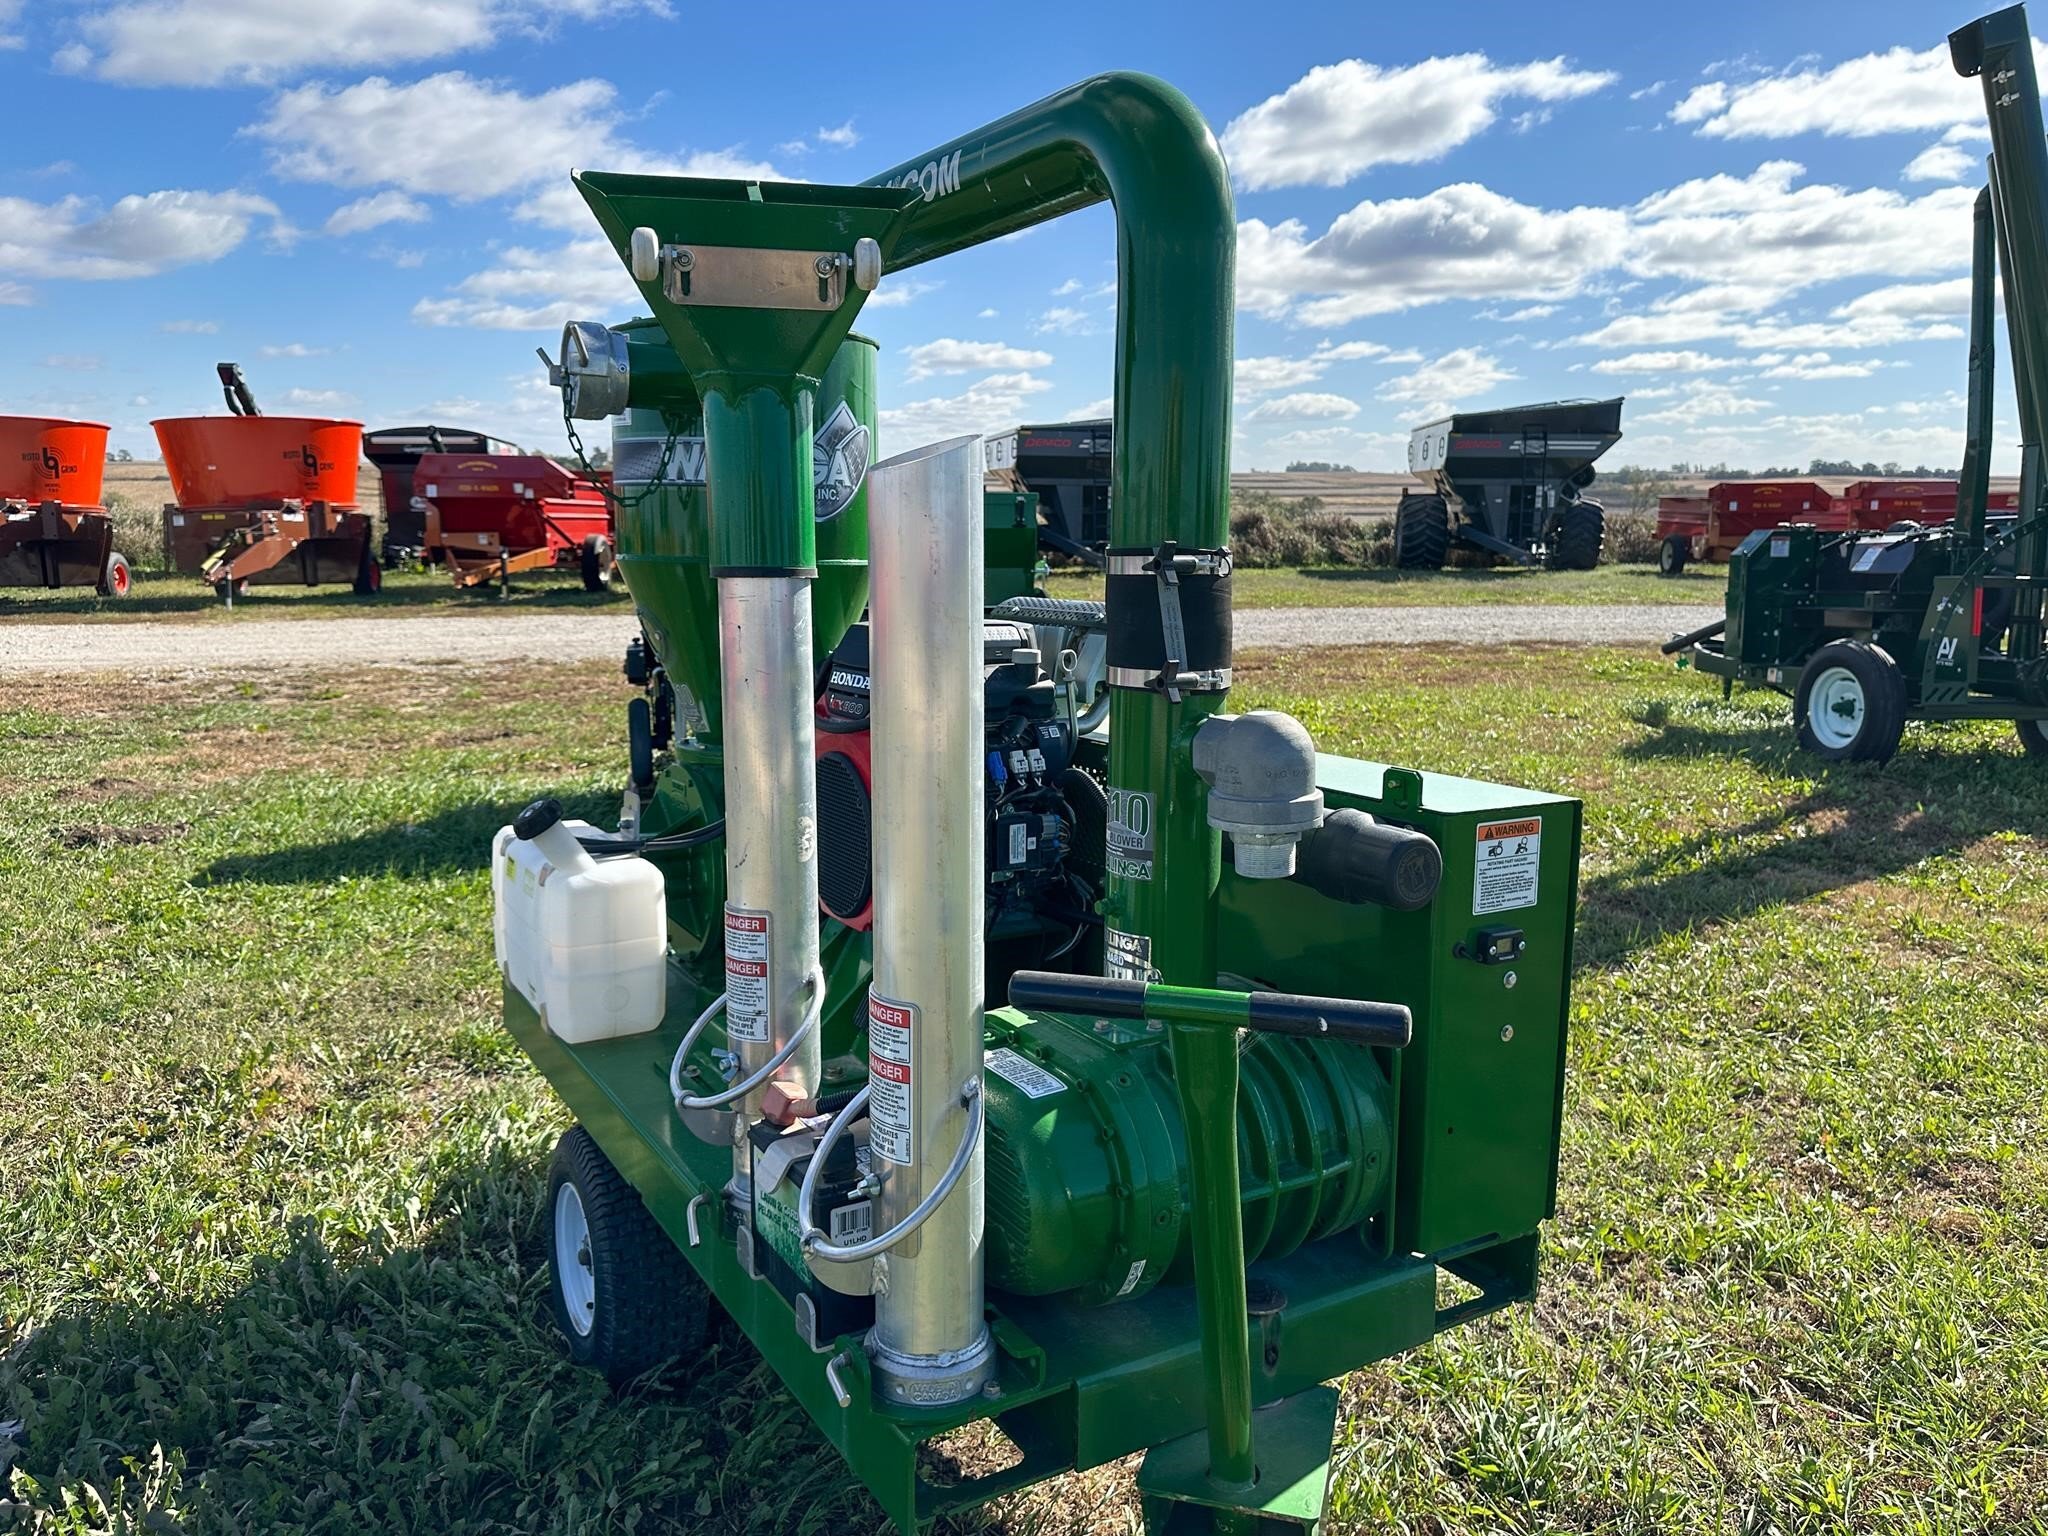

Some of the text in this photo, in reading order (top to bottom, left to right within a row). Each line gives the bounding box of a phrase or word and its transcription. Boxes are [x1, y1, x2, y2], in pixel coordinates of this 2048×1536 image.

[817, 487, 840, 501] INC.
[831, 671, 871, 690] HONDA
[1495, 823, 1534, 836] WARNING
